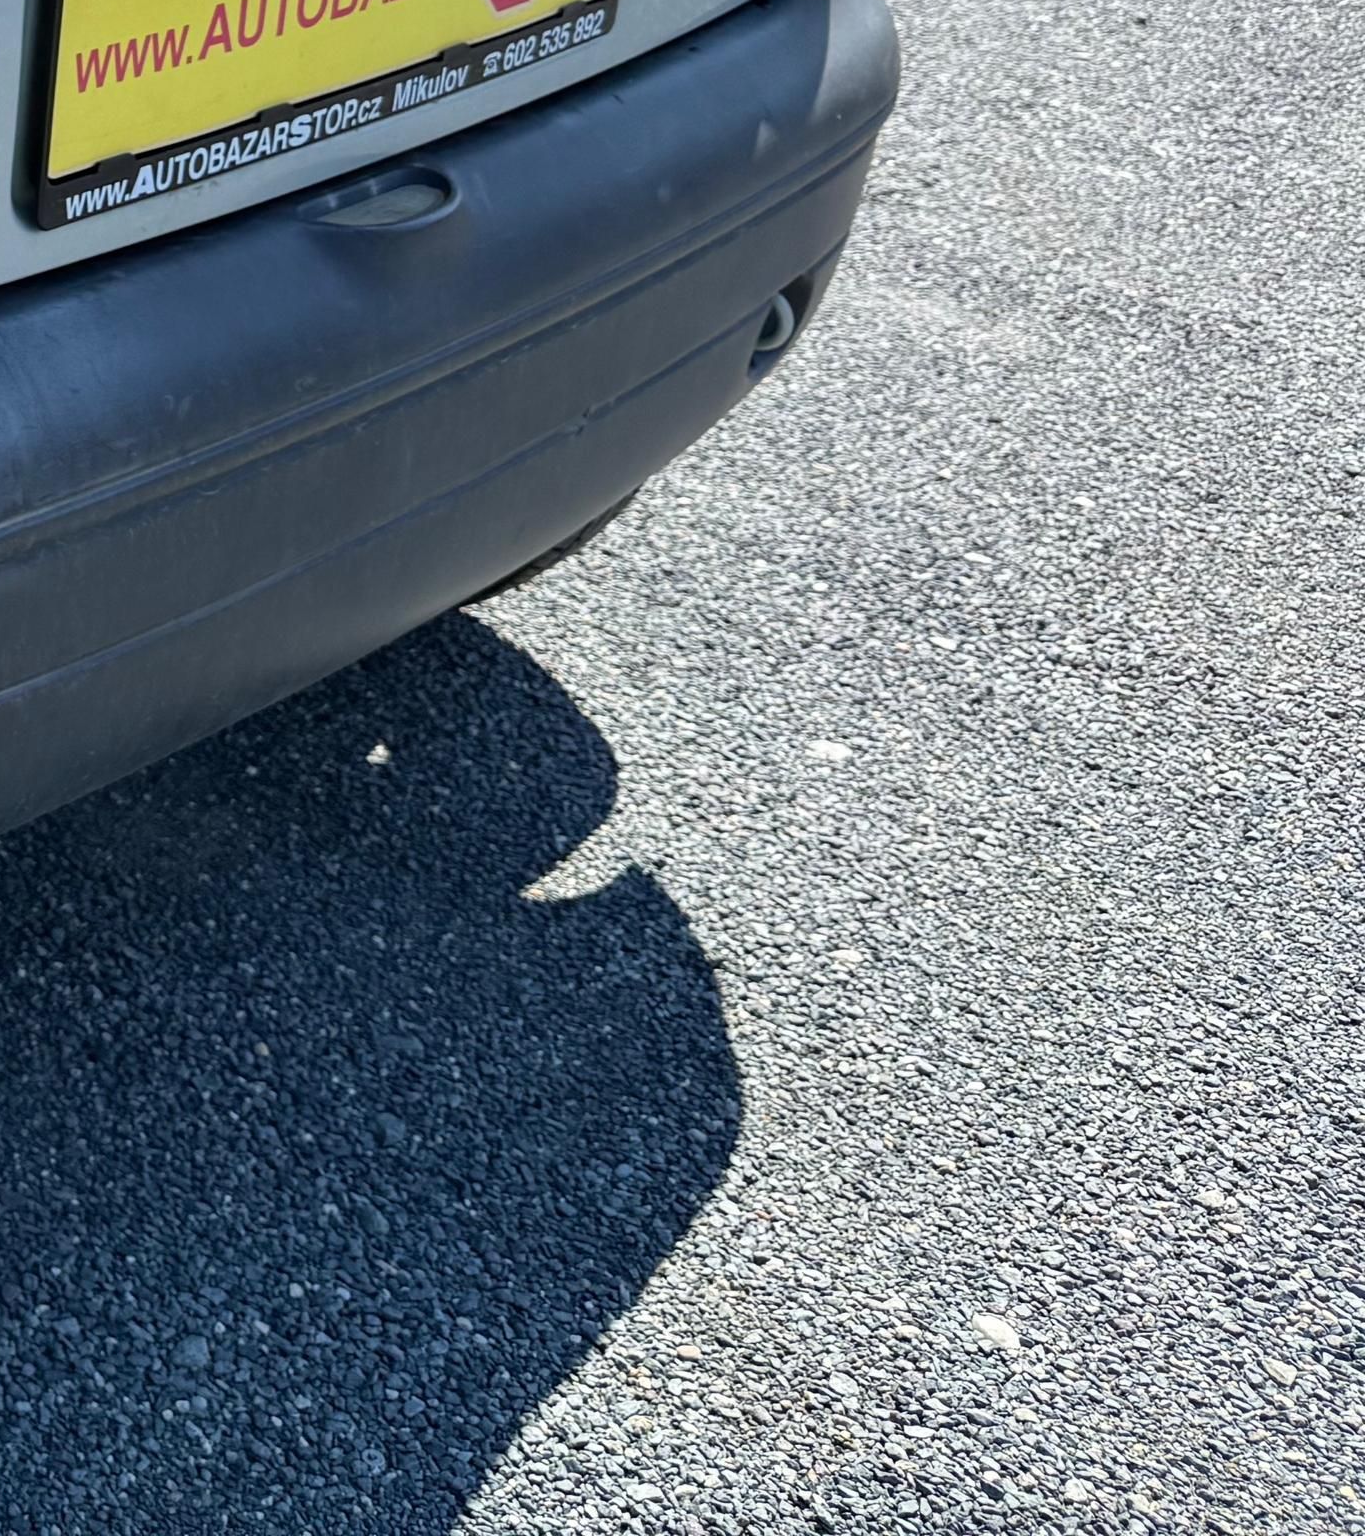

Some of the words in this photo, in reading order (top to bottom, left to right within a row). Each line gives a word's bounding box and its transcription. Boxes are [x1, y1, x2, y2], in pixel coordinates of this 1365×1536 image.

[392, 64, 469, 113] Mikulov
[502, 37, 537, 71] 602
[538, 21, 572, 58] 535
[572, 8, 606, 42] 892
